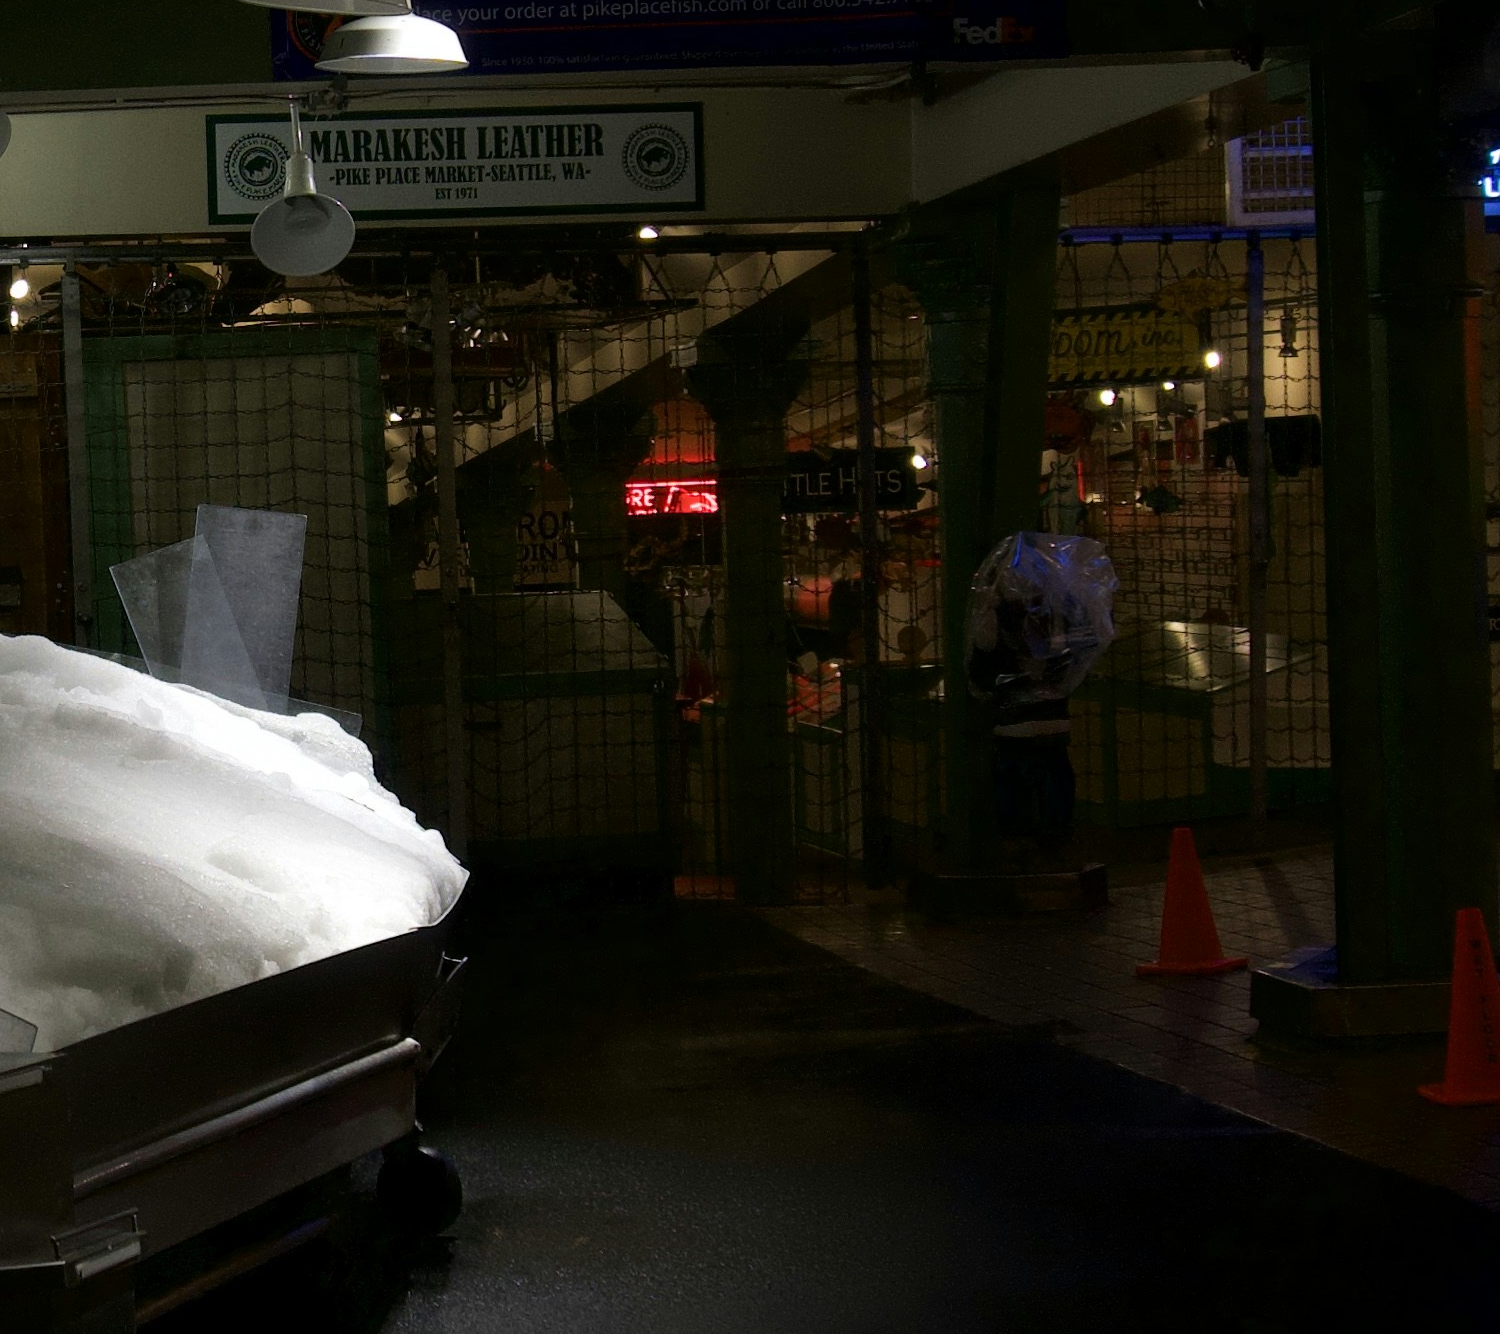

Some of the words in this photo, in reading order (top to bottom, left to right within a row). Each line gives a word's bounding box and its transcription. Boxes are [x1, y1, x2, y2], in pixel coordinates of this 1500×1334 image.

[412, 7, 452, 23] lace
[459, 8, 498, 25] your
[506, 2, 555, 20] order
[560, 2, 577, 17] at
[952, 16, 1038, 46] FedEx
[309, 127, 467, 163] MARAKESH
[476, 123, 605, 160] LEATHER
[376, 168, 421, 184] PLACE
[434, 188, 452, 200] EST
[455, 187, 479, 199] 1971
[838, 467, 903, 496] HTS
